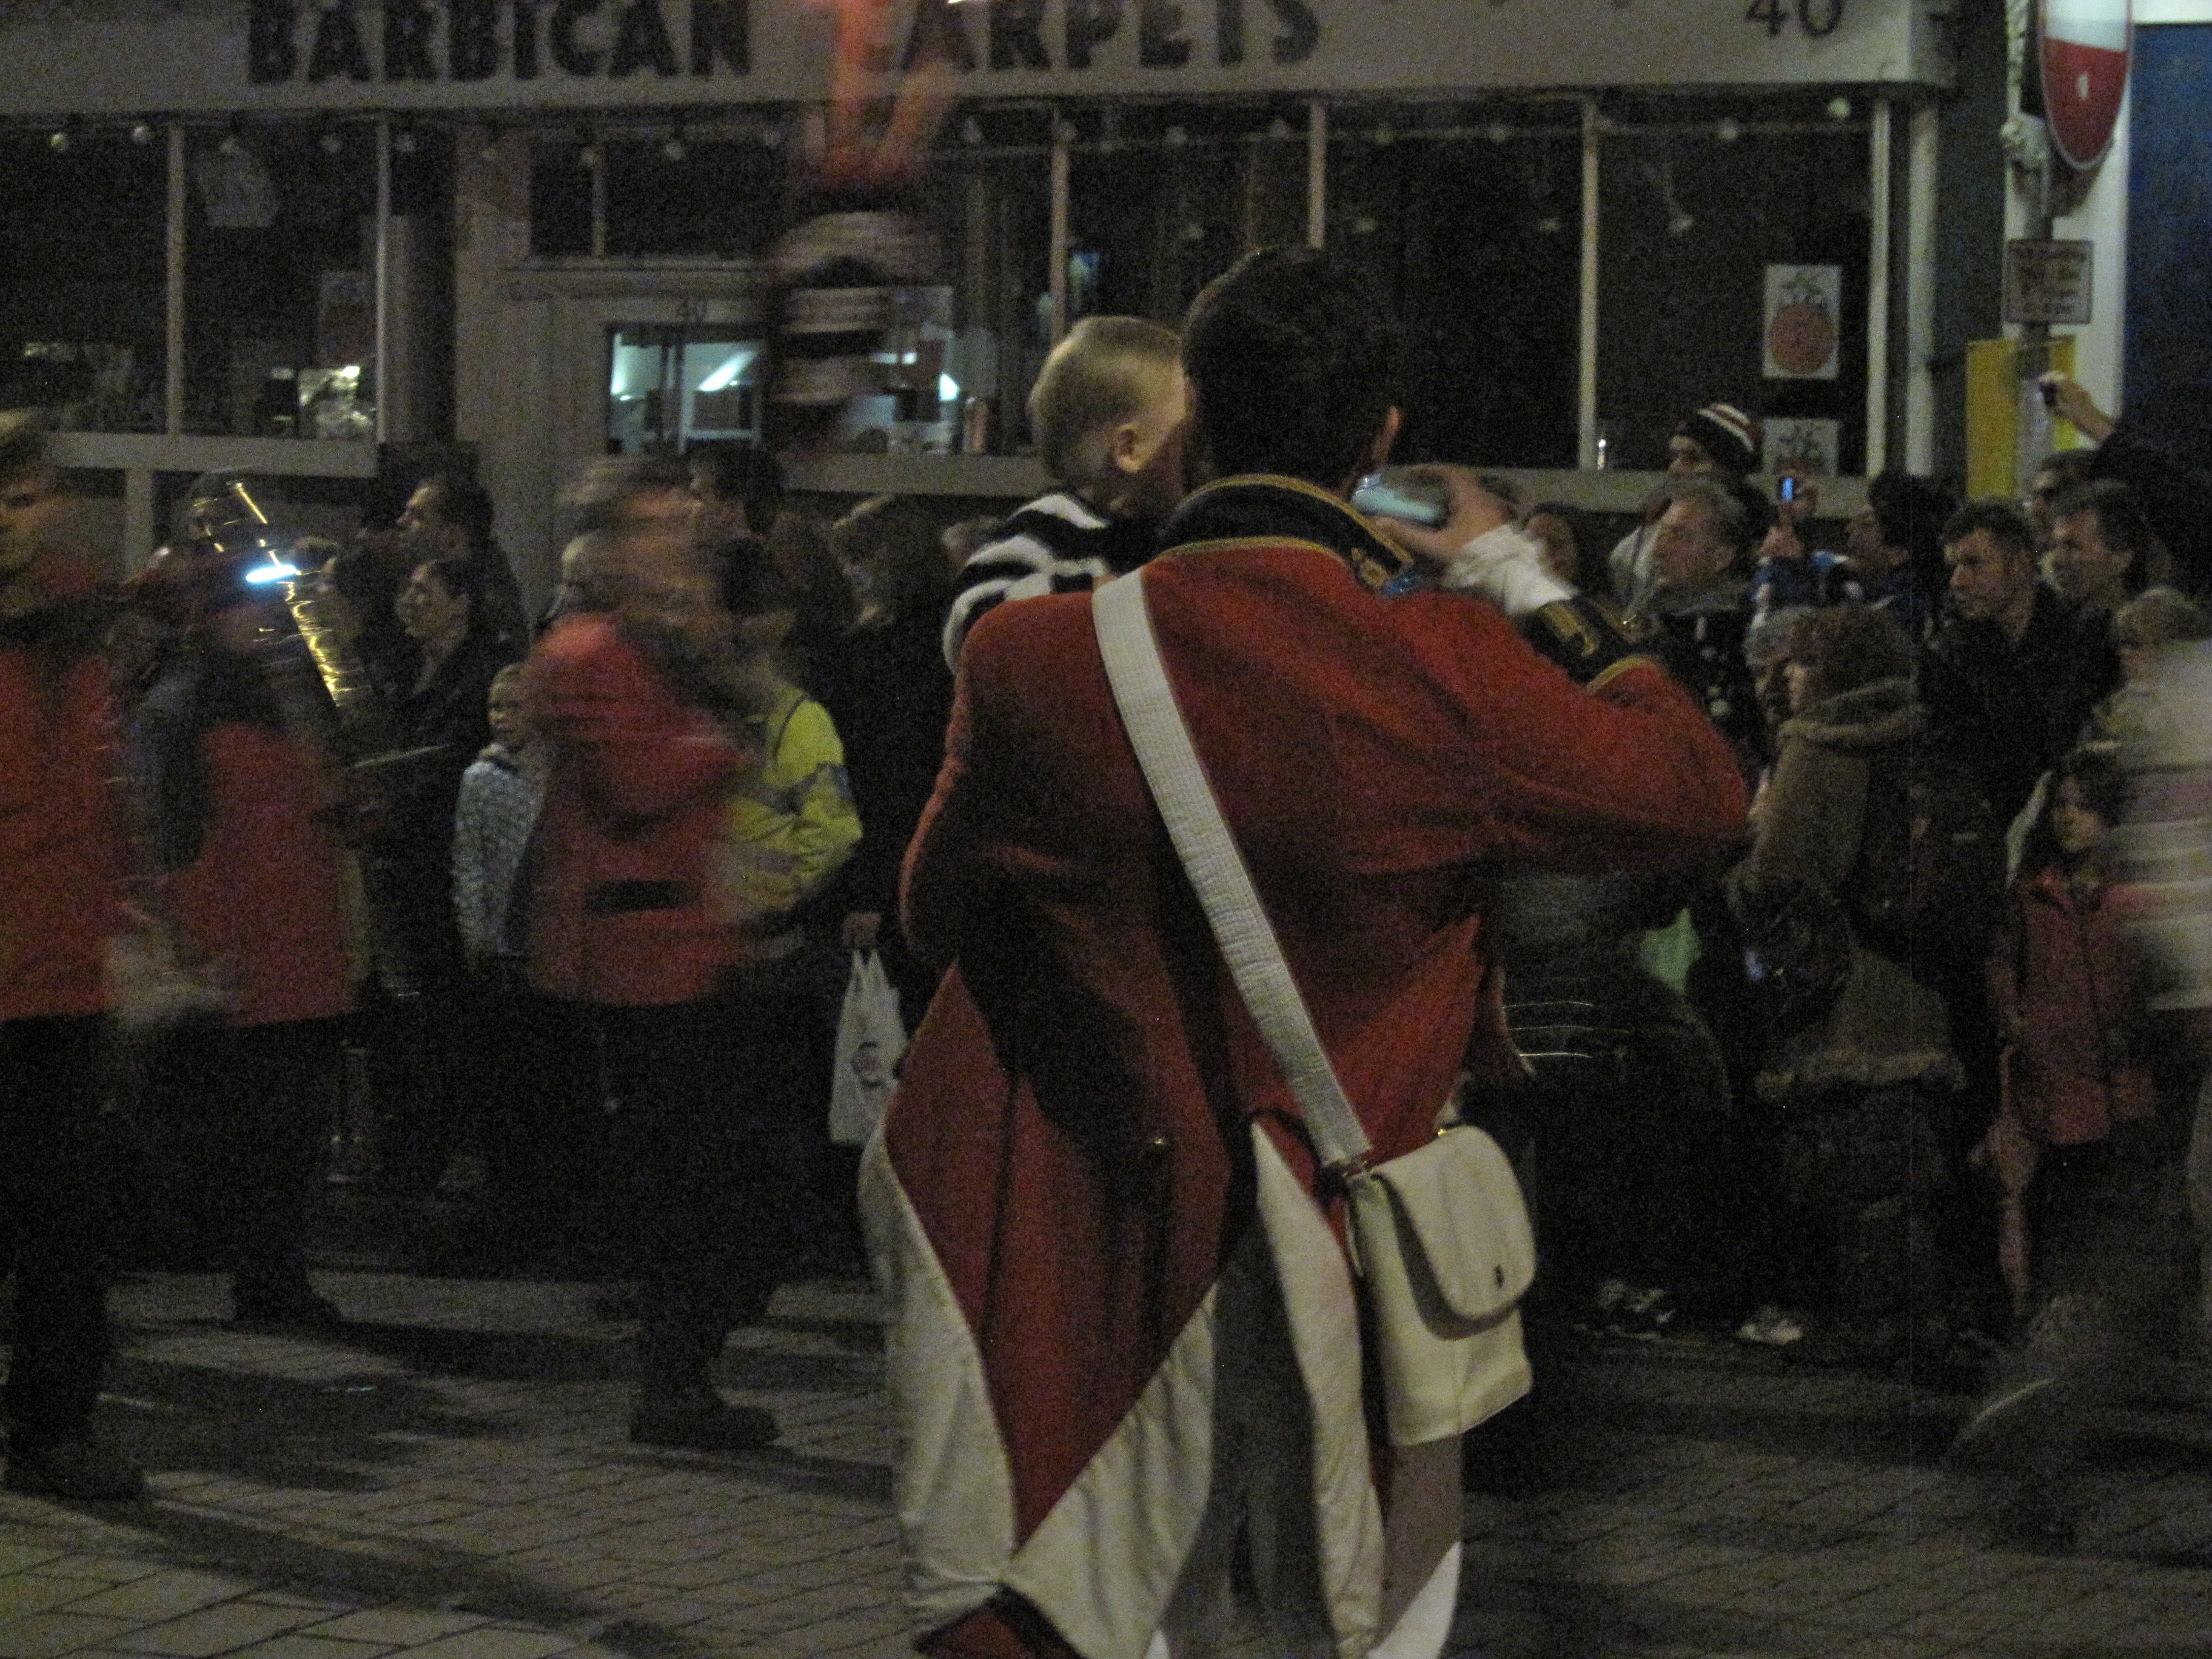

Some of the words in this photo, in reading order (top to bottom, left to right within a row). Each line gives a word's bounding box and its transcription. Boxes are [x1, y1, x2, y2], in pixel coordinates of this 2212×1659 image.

[246, 0, 752, 81] BARBICAN
[844, 0, 1319, 69] ARPETS
[1746, 0, 1843, 38] 40
